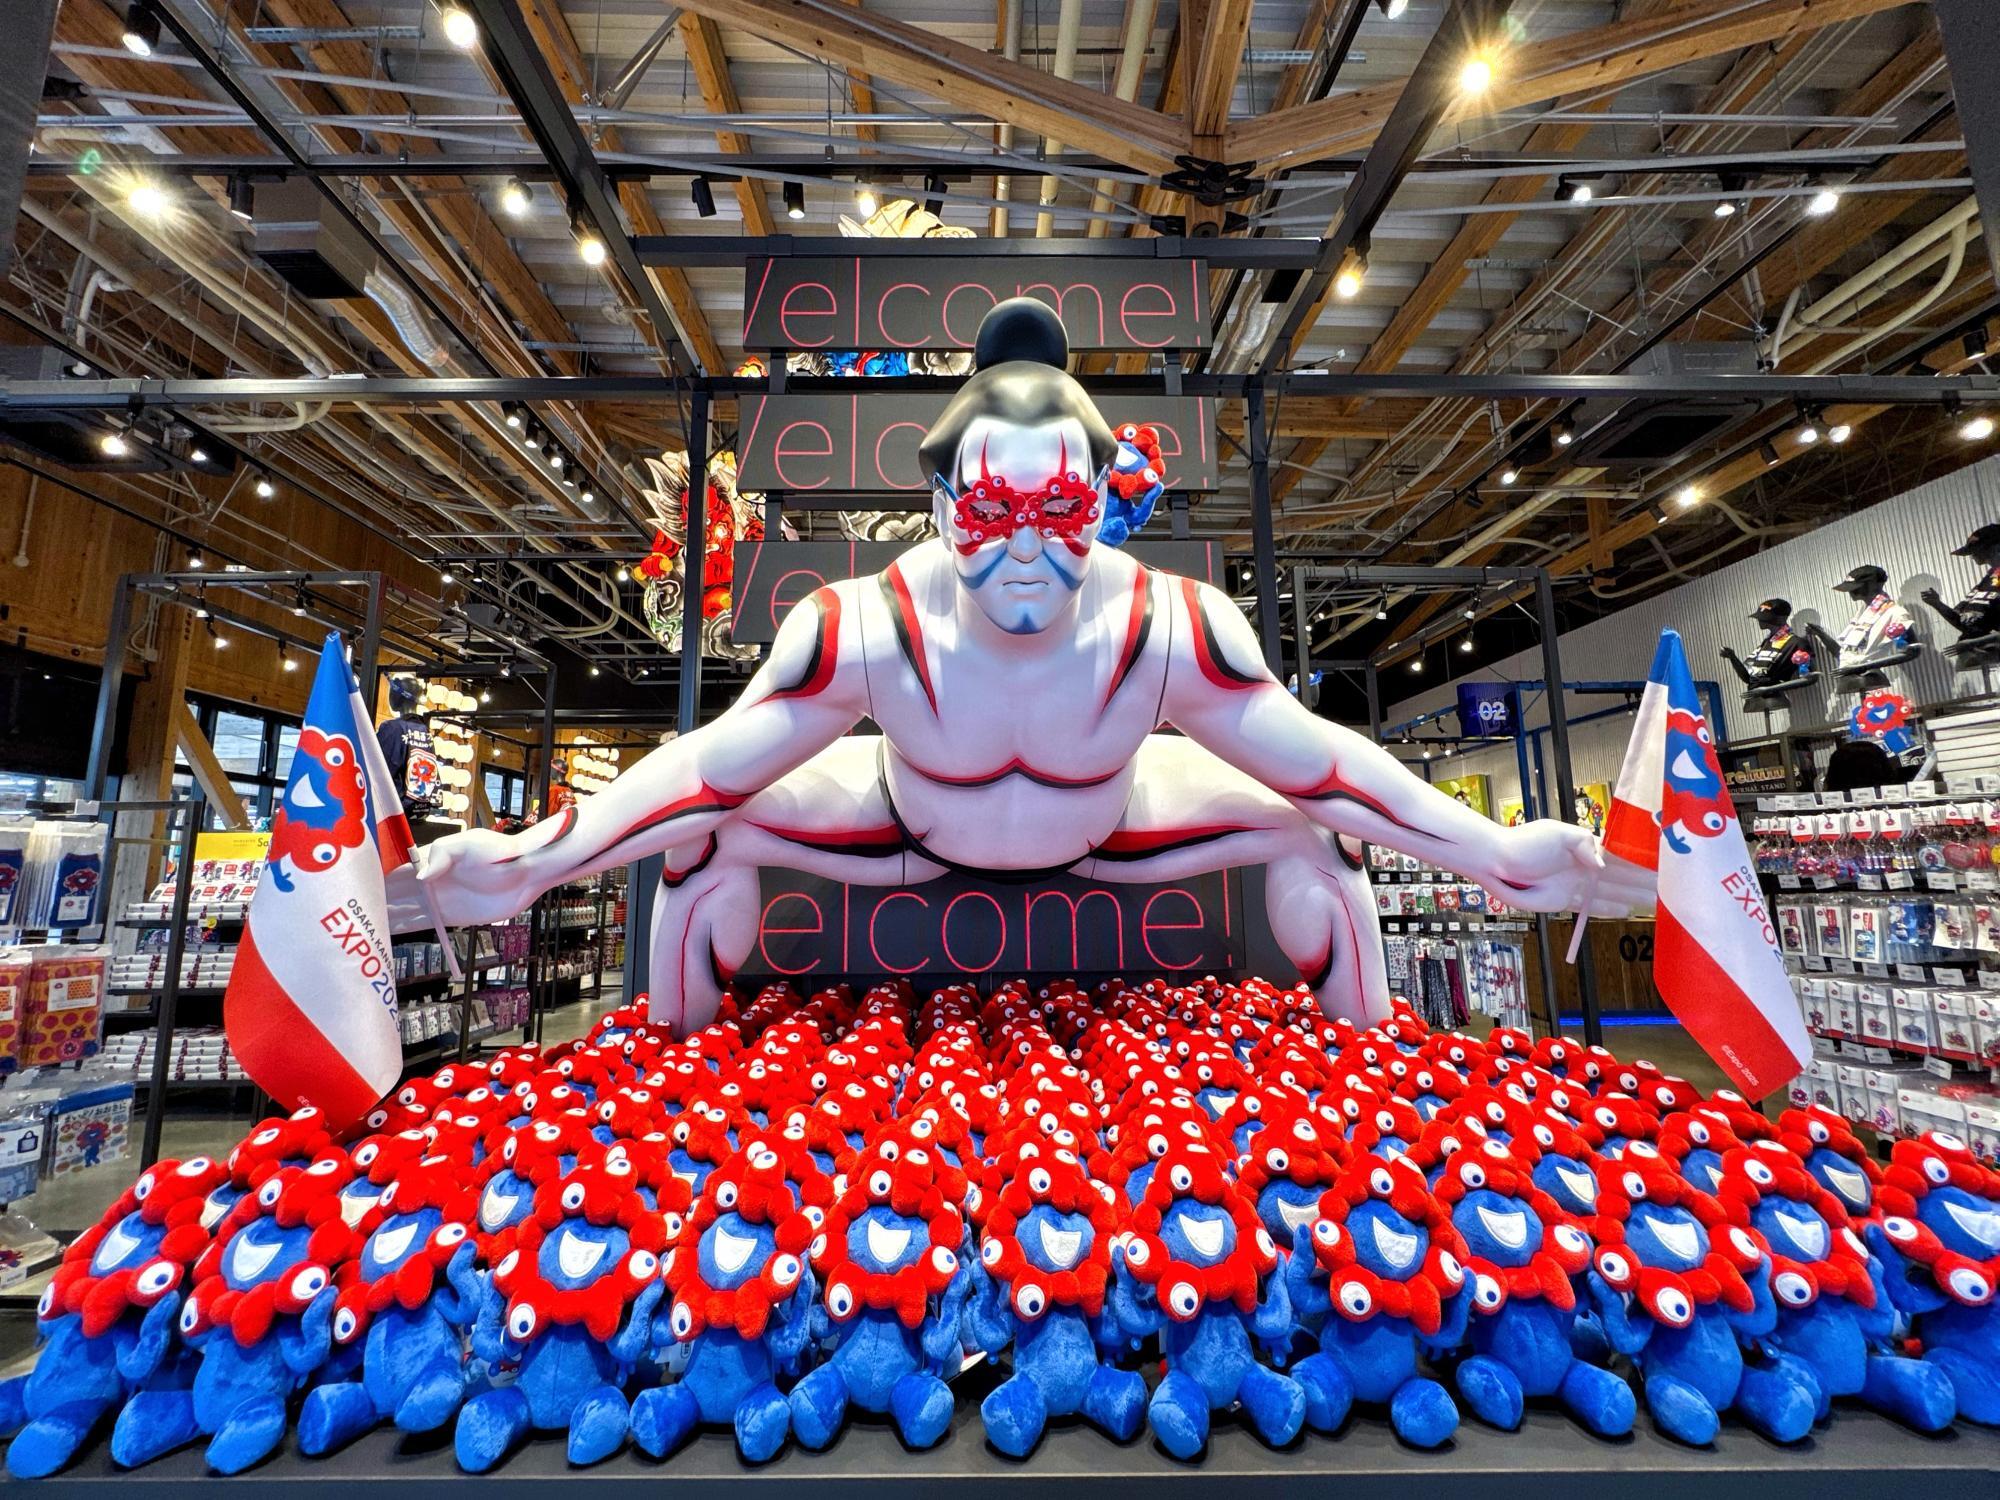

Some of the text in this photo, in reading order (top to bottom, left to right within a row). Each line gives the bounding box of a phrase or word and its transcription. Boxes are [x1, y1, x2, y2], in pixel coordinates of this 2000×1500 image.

[743, 258, 1202, 347] elcome!
[1478, 701, 1506, 721] 02
[347, 898, 376, 942] OSAKA,
[759, 869, 1233, 975] elcome!
[1619, 934, 1654, 962] 02
